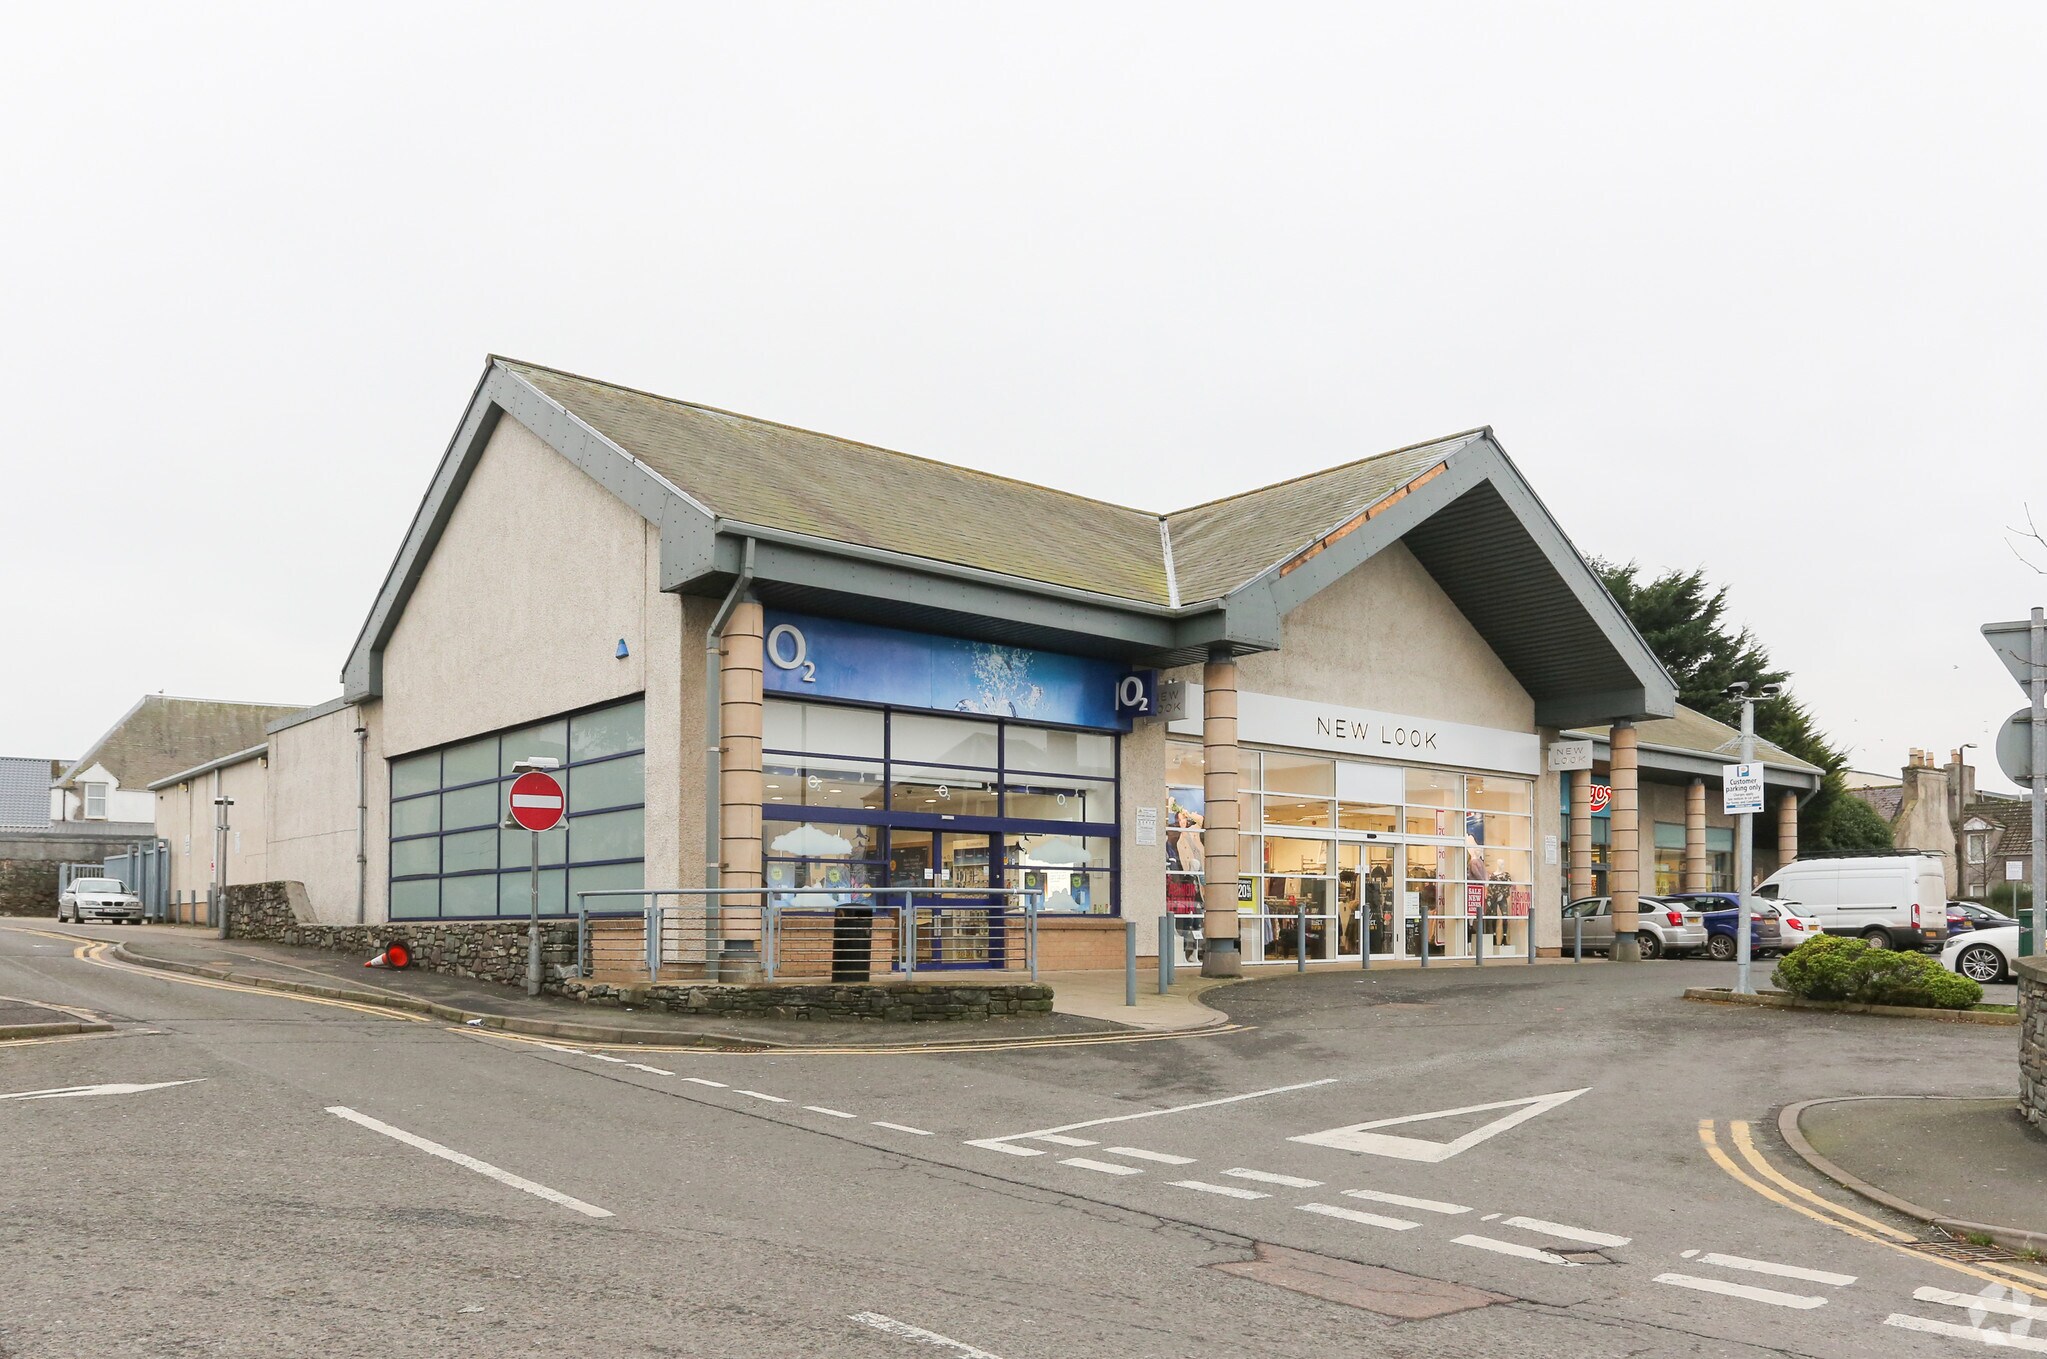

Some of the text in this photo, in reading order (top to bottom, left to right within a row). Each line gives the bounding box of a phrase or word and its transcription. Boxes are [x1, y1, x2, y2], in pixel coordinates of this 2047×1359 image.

[767, 624, 816, 682] O2
[1316, 716, 1437, 750] NEW LOOK
[1557, 747, 1583, 755] NEW
[1554, 756, 1586, 765] LOOK
[1726, 785, 1747, 793] parking
